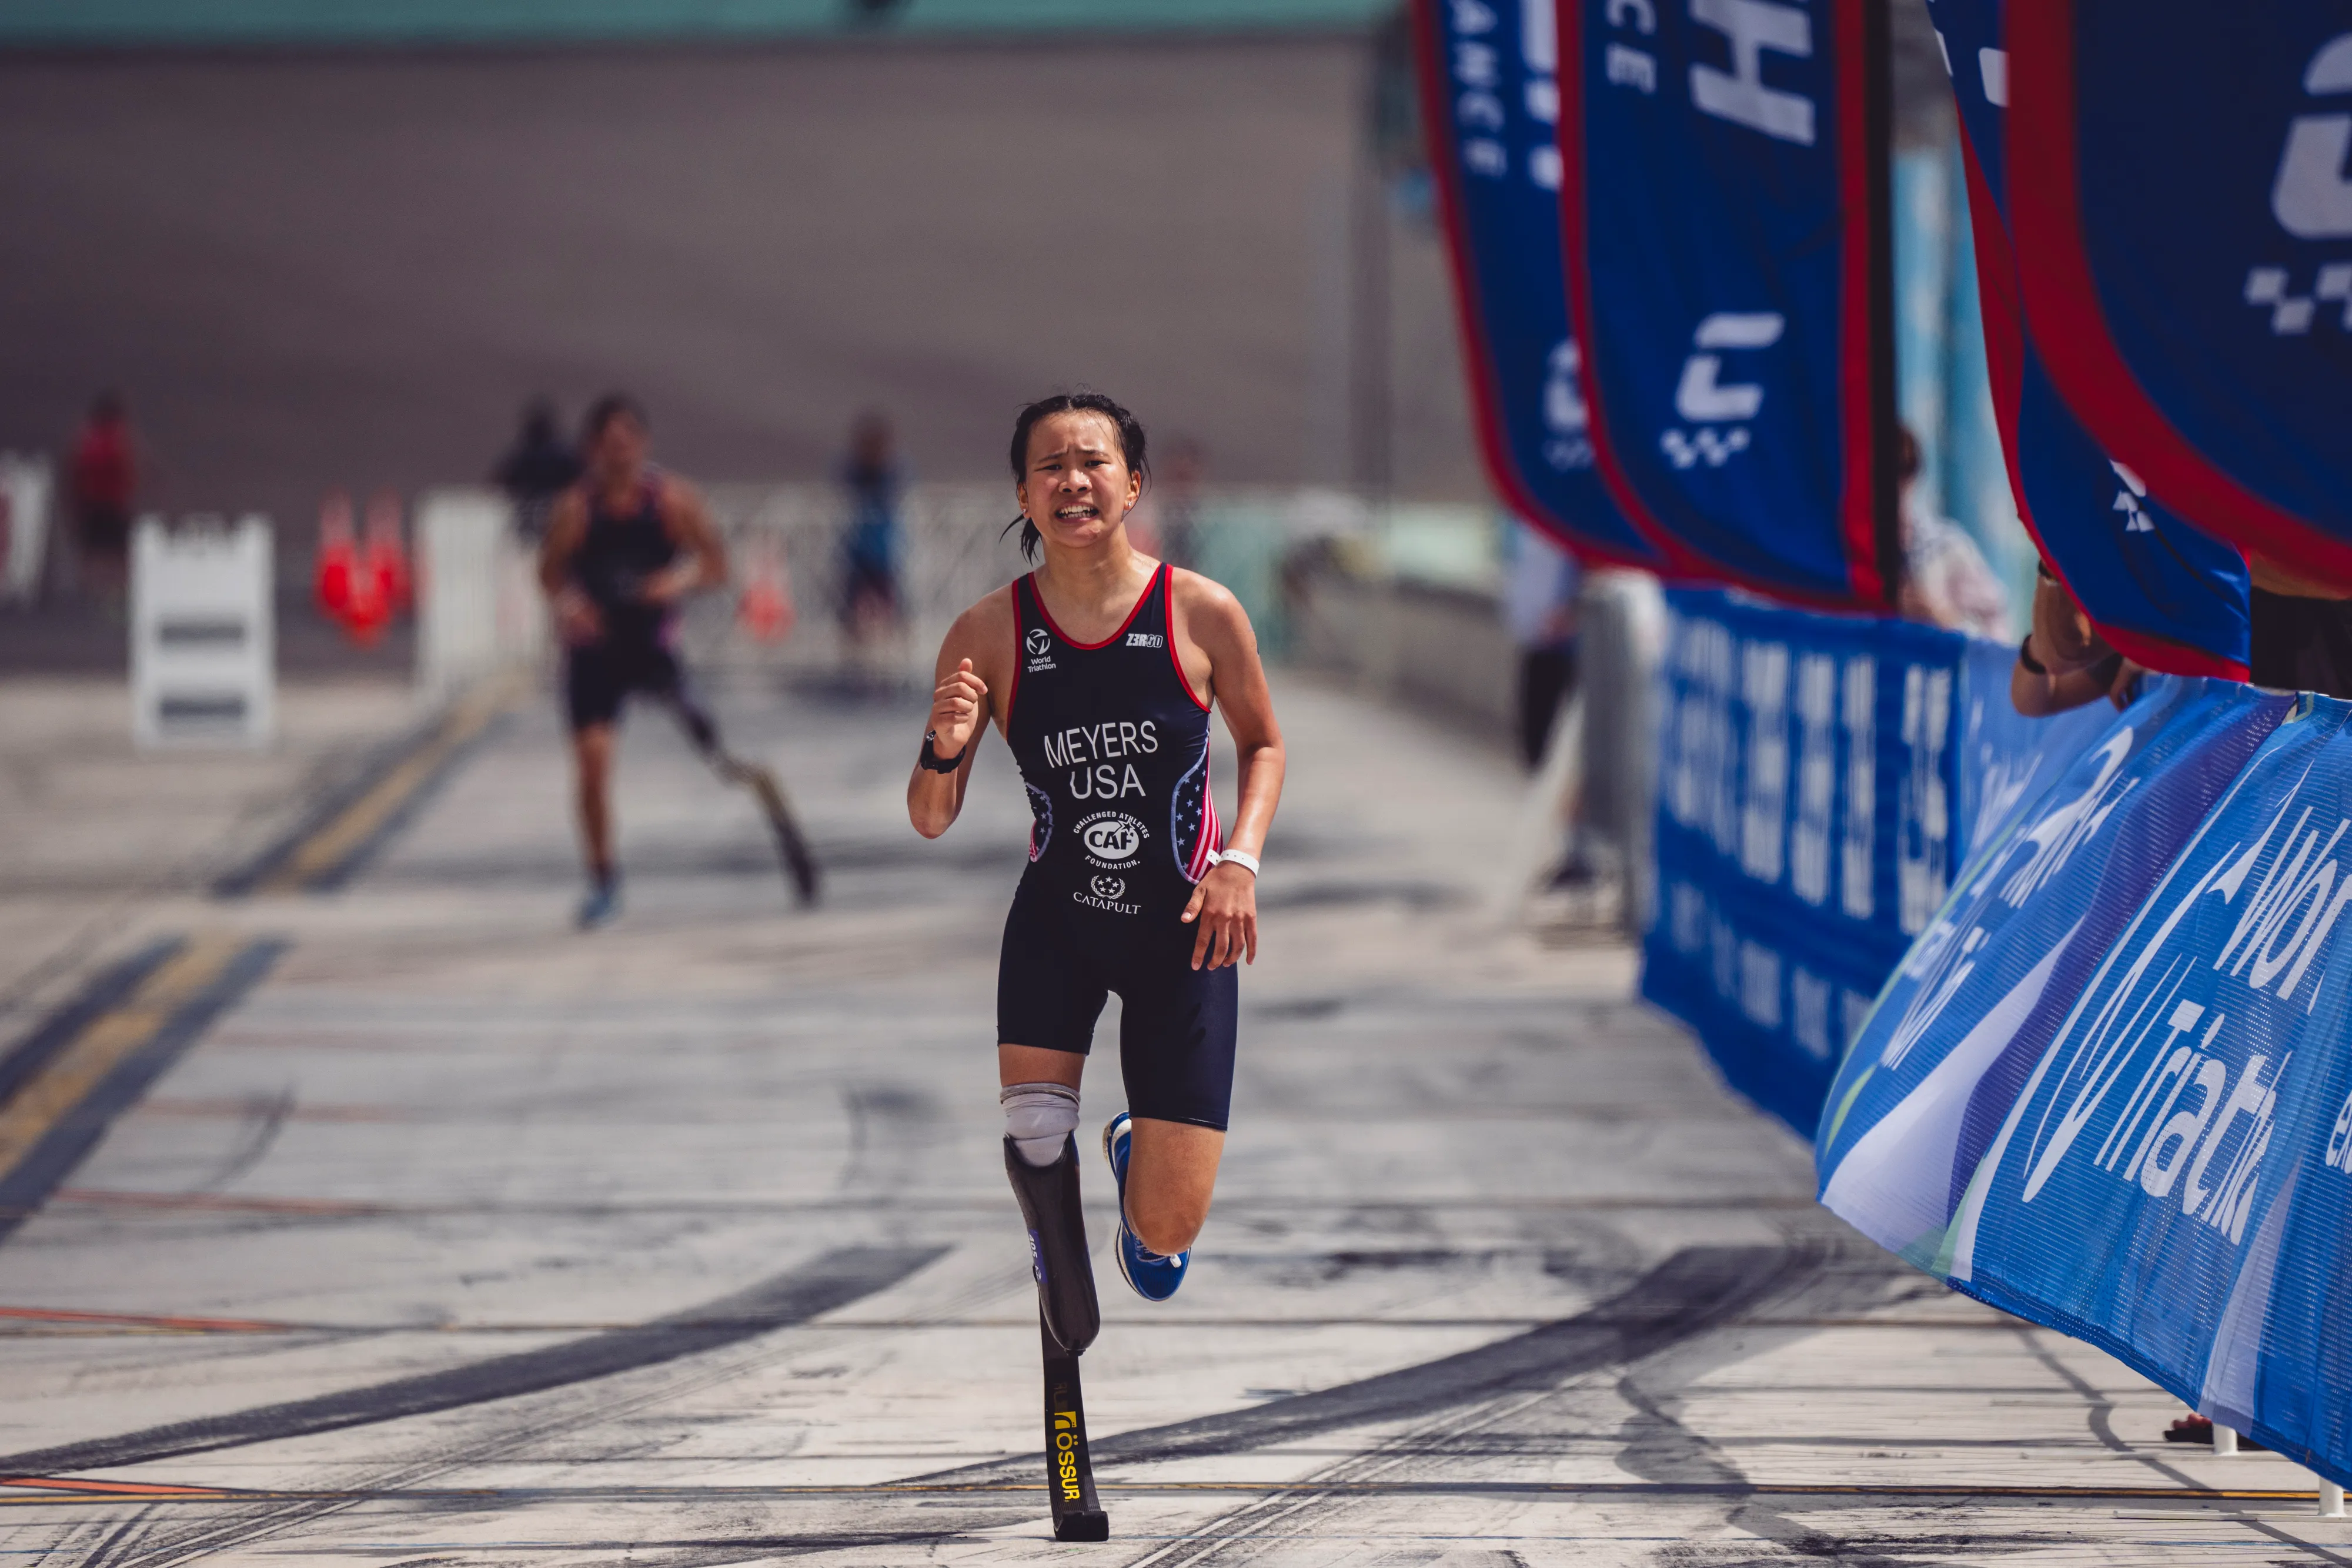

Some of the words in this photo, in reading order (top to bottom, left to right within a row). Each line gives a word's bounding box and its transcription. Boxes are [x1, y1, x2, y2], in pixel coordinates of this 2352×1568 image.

[1027, 663, 1057, 673] Triathlon
[1031, 656, 1051, 665] World
[1044, 720, 1158, 768] MEYERS
[1069, 764, 1146, 800] USA
[1073, 811, 1117, 834] CHALLENGED
[1119, 813, 1150, 839] ATHLETES
[1088, 830, 1134, 850] CAF
[1073, 892, 1141, 915] CATAPULT
[1056, 1432, 1080, 1500] ÖSSUR
